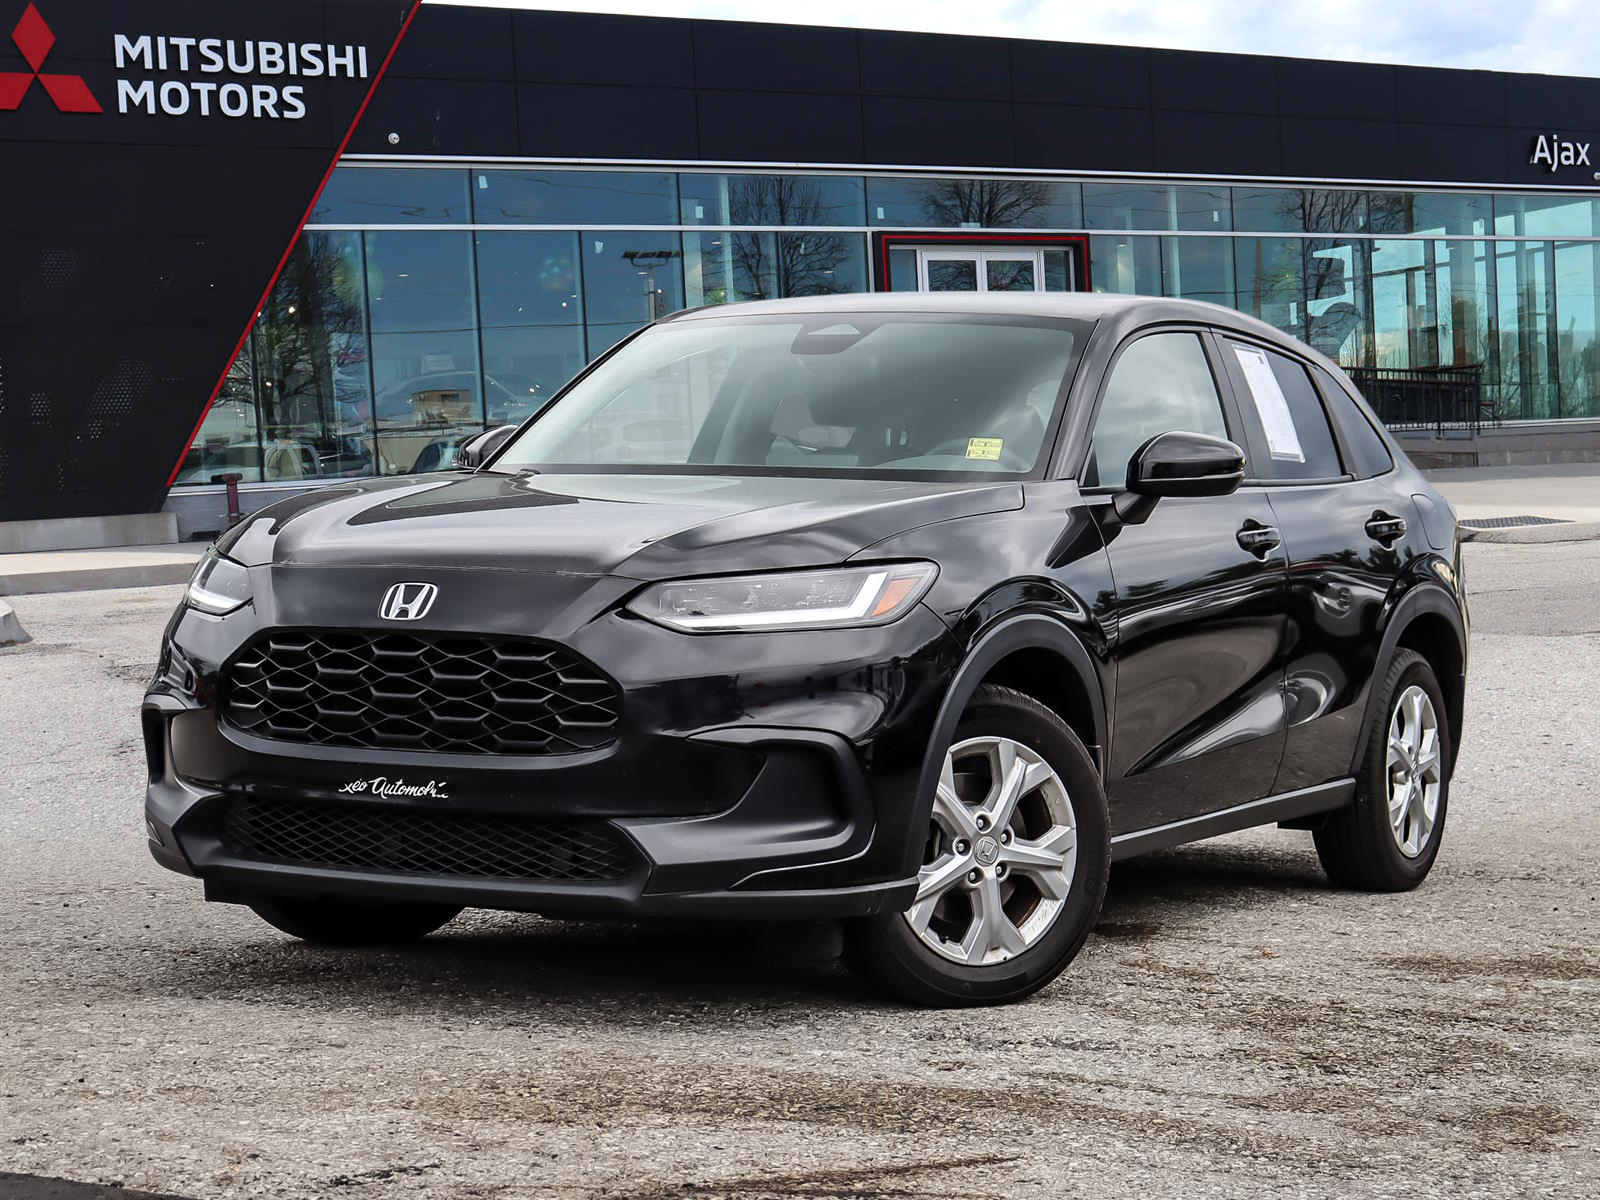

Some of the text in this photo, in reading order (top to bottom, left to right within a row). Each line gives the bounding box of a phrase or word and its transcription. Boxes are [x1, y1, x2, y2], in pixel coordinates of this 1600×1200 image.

[114, 34, 368, 78] MITSUBISHI
[117, 79, 306, 119] MOTORS
[1533, 134, 1591, 173] Ajax
